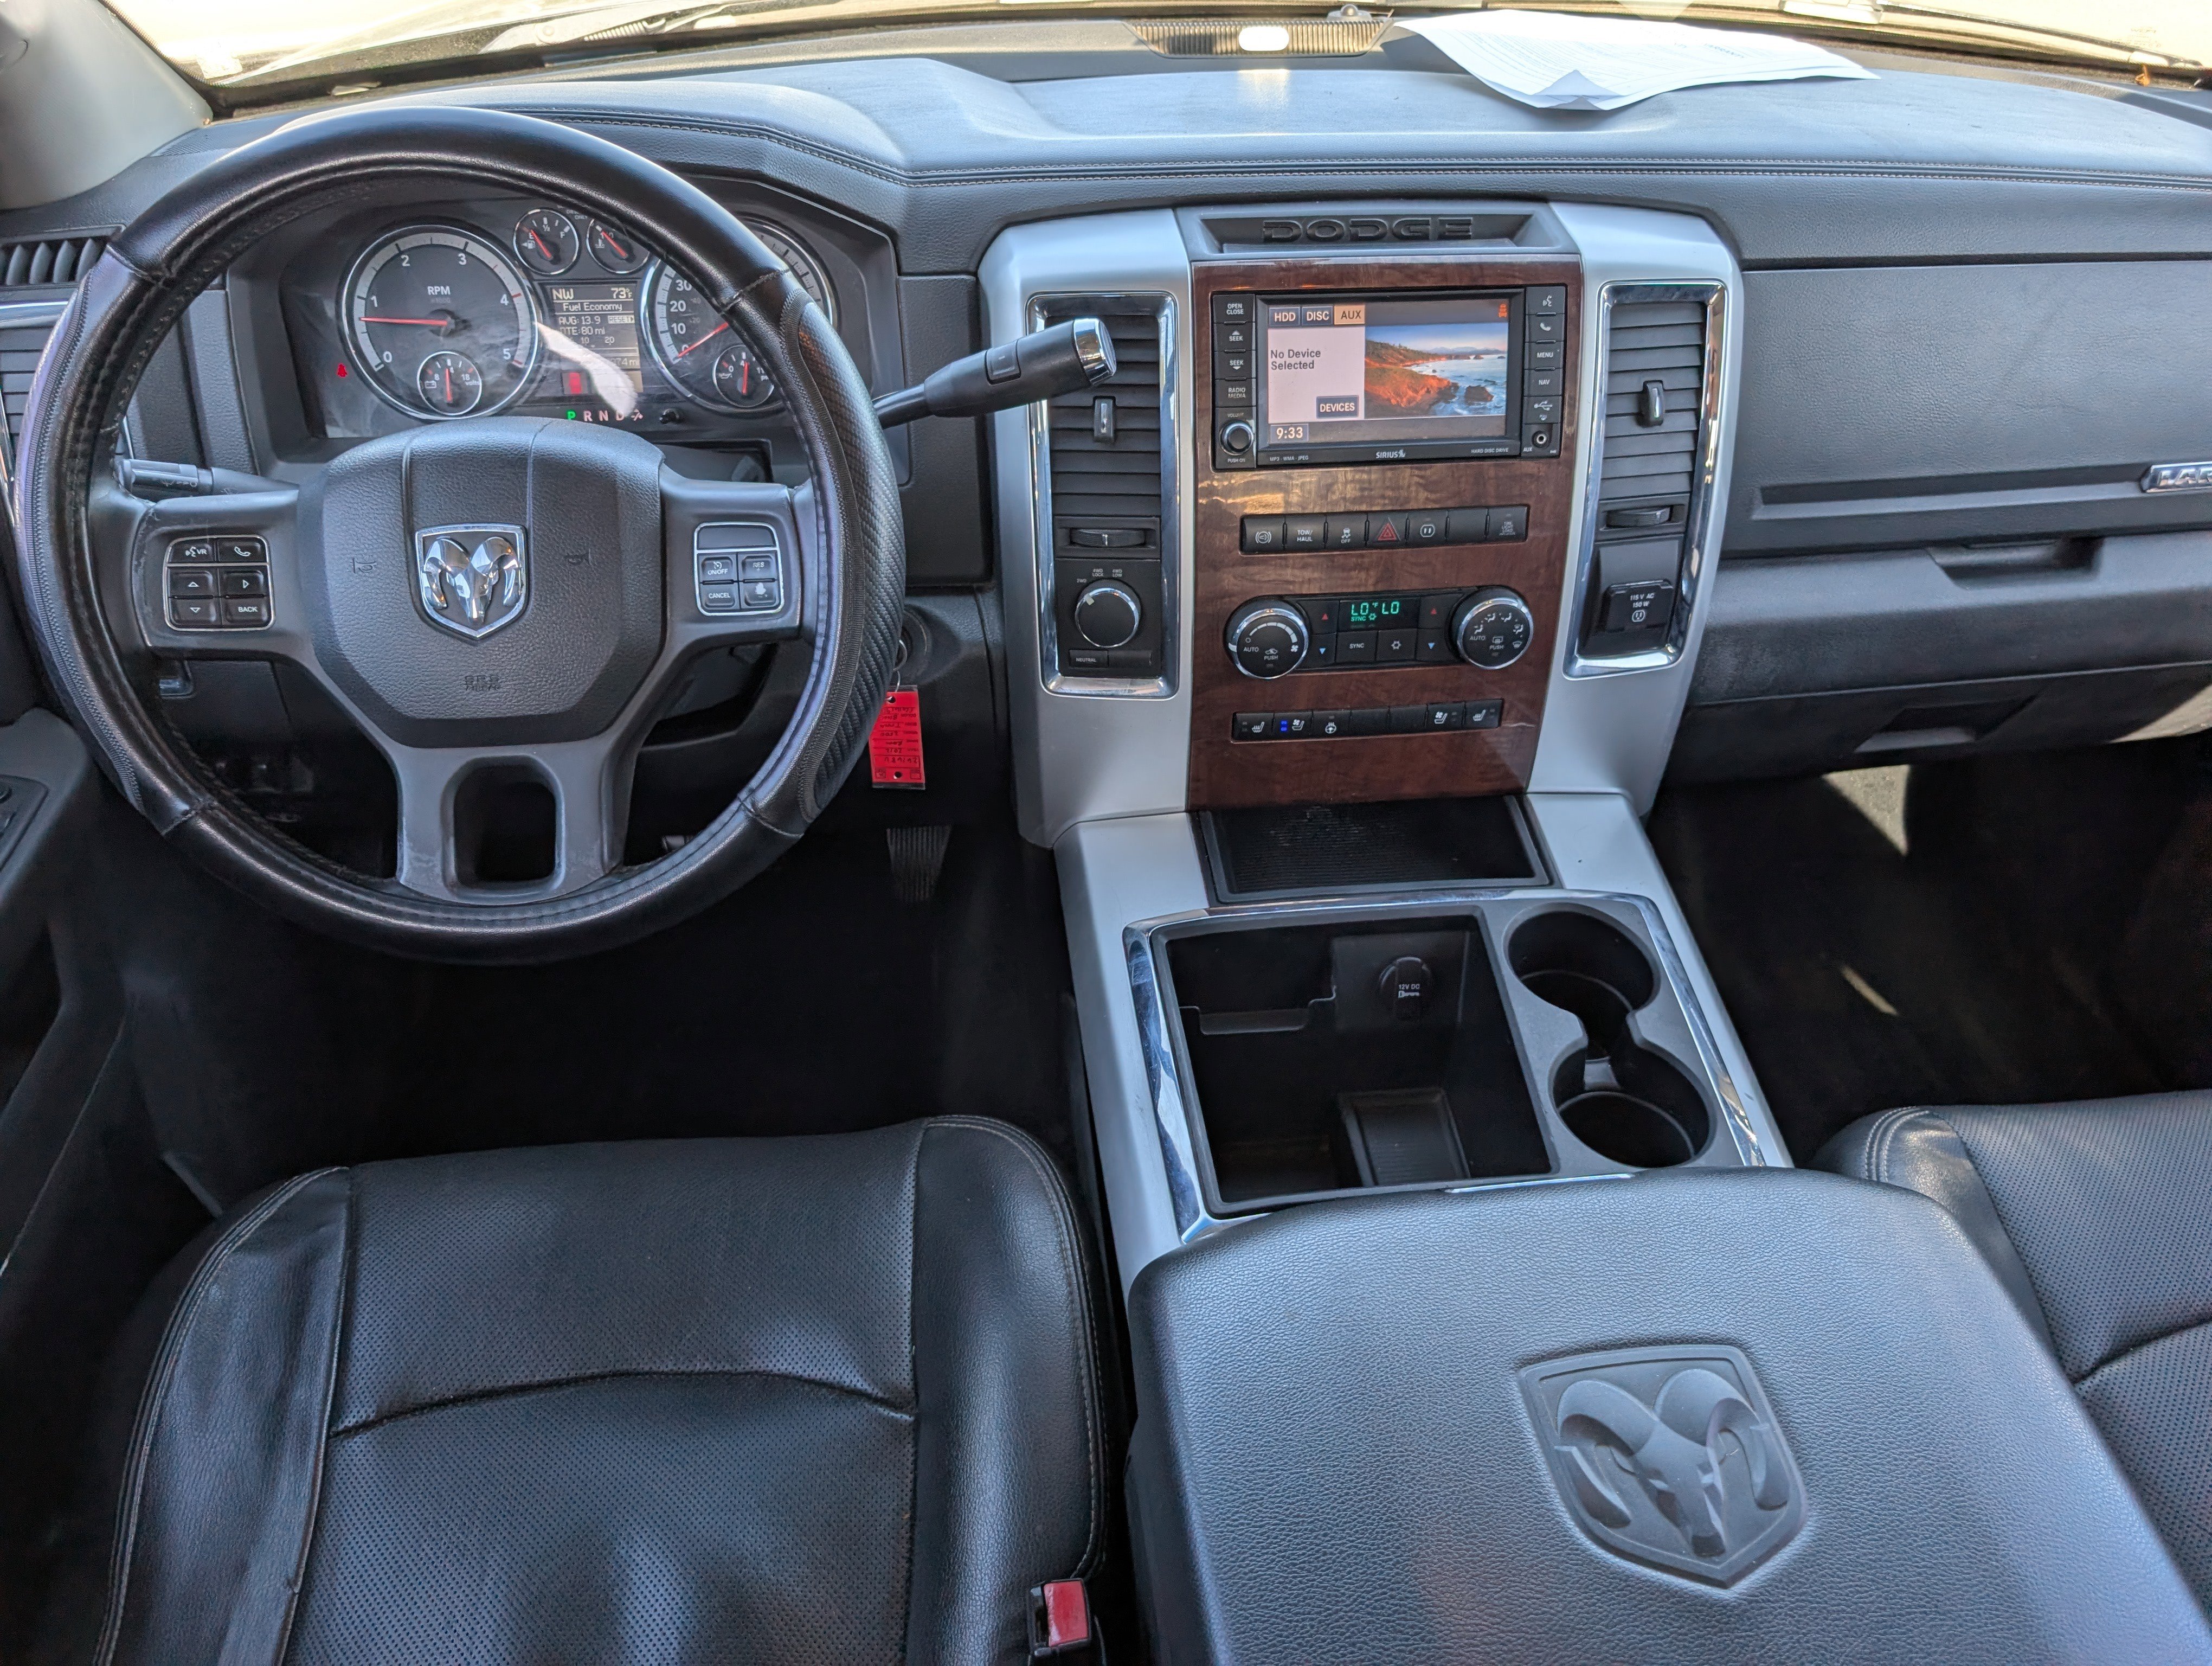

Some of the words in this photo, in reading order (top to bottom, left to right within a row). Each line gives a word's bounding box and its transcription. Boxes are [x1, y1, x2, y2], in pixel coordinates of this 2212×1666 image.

[1263, 217, 1472, 241] DODGE
[402, 255, 410, 267] 2
[458, 254, 467, 265] 3
[427, 286, 451, 295] RPM
[676, 280, 692, 291] 30
[500, 294, 509, 305] 4
[552, 288, 574, 300] NW
[371, 296, 378, 307] 1
[563, 303, 581, 311] Fuel
[584, 302, 622, 312] Economy
[670, 300, 686, 312] 20
[1275, 312, 1296, 322] HDD
[1307, 311, 1329, 321] DISC
[1341, 310, 1362, 319] AUX
[558, 316, 579, 325] AVG:
[581, 316, 601, 325] 13.9
[581, 327, 594, 335] 80
[671, 323, 686, 335] 10
[383, 352, 393, 363] 0
[503, 349, 511, 360] 5
[1271, 350, 1284, 358] No
[1288, 349, 1321, 358] Device
[1271, 360, 1314, 370] Selected
[1320, 403, 1355, 412] DEVICES
[567, 410, 576, 420] P
[583, 411, 593, 421] R
[599, 410, 609, 421] N
[1276, 426, 1303, 439] 9:33
[1376, 451, 1398, 459] SIRIUS
